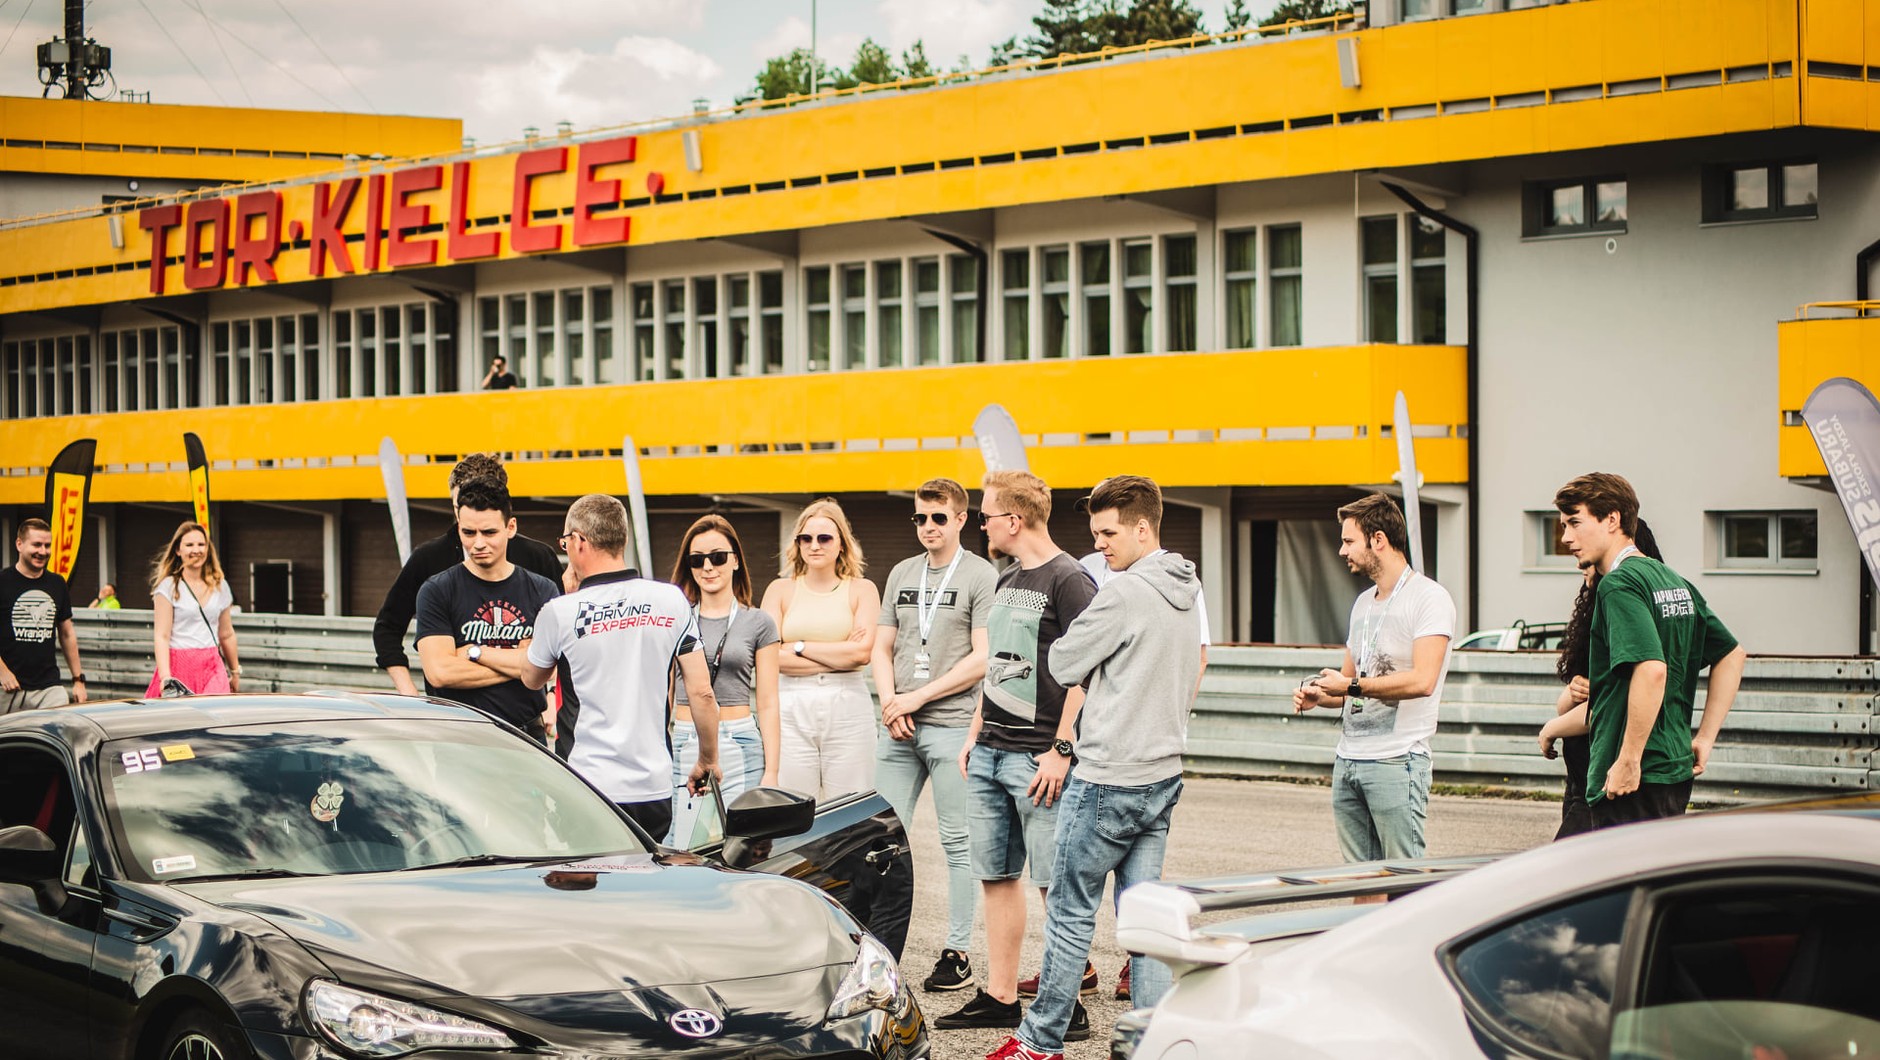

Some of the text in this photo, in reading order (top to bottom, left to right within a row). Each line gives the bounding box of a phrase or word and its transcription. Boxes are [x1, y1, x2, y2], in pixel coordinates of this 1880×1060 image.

[54, 487, 79, 574] RELLI
[593, 604, 651, 622] DRIVING
[13, 626, 52, 643] Wrangler
[591, 615, 675, 635] EXPERIENCE
[122, 747, 162, 774] 95
